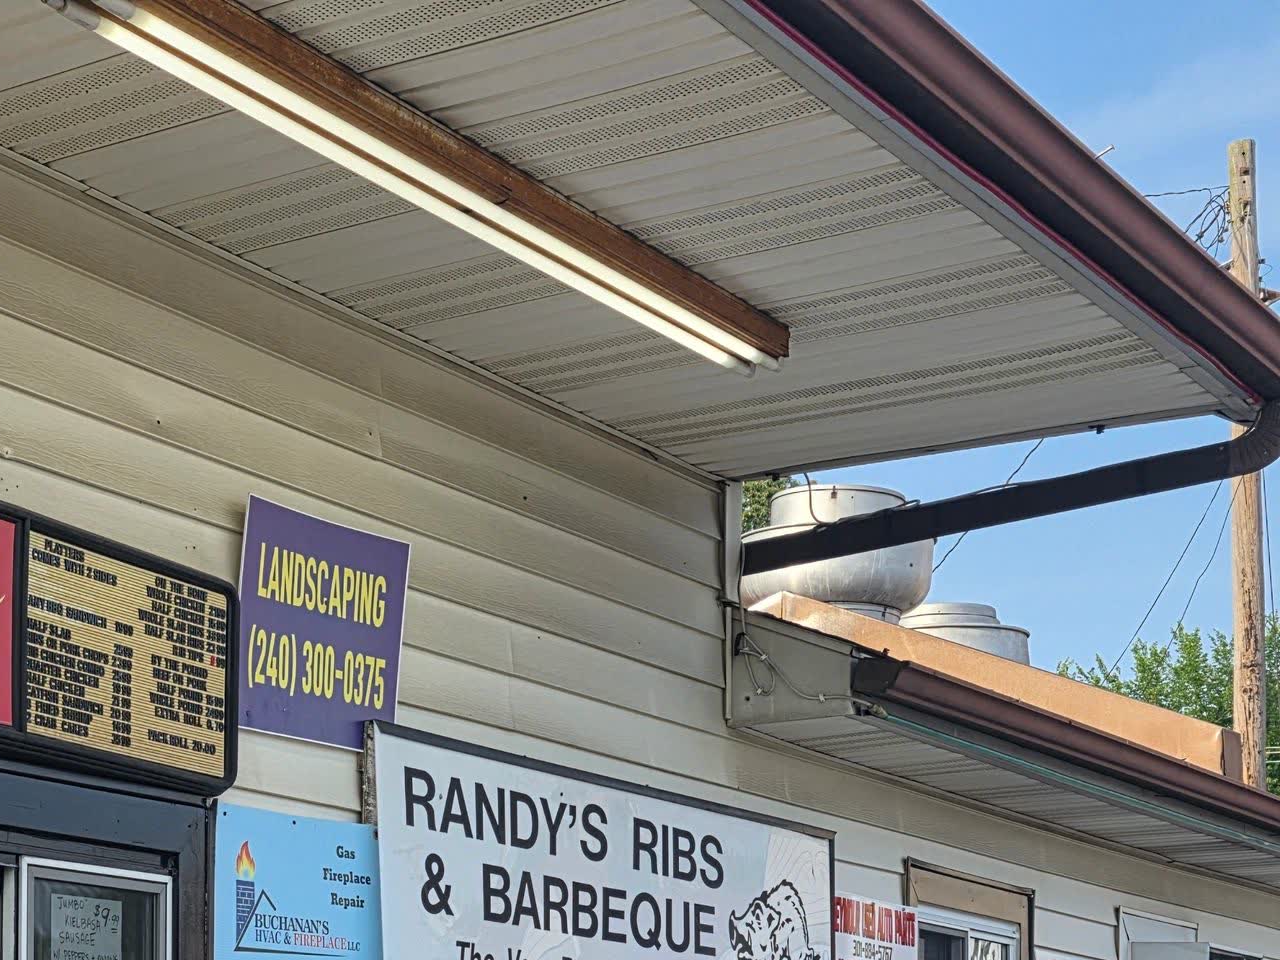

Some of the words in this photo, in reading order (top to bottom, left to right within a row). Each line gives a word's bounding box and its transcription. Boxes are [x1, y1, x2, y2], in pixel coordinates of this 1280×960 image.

[32, 549, 60, 567] COMES
[64, 558, 84, 576] WITH
[86, 566, 92, 578] 2
[93, 569, 117, 586] SIDES
[257, 542, 386, 627] LANDSCAPING
[247, 624, 297, 697] (240)
[302, 643, 386, 710] 300-0375
[403, 766, 609, 862] RANDY'S
[632, 817, 724, 889] RIBS
[336, 846, 355, 860] Gas
[322, 868, 371, 885] Fireplace
[330, 893, 365, 909] Repair
[421, 853, 454, 916] &
[482, 863, 716, 956] BARBEQUE
[254, 914, 329, 935] BUCHANAN'S
[255, 929, 282, 944] HVAC
[283, 932, 291, 945] &
[293, 933, 347, 950] FIREPLACE
[348, 942, 360, 952] LLC
